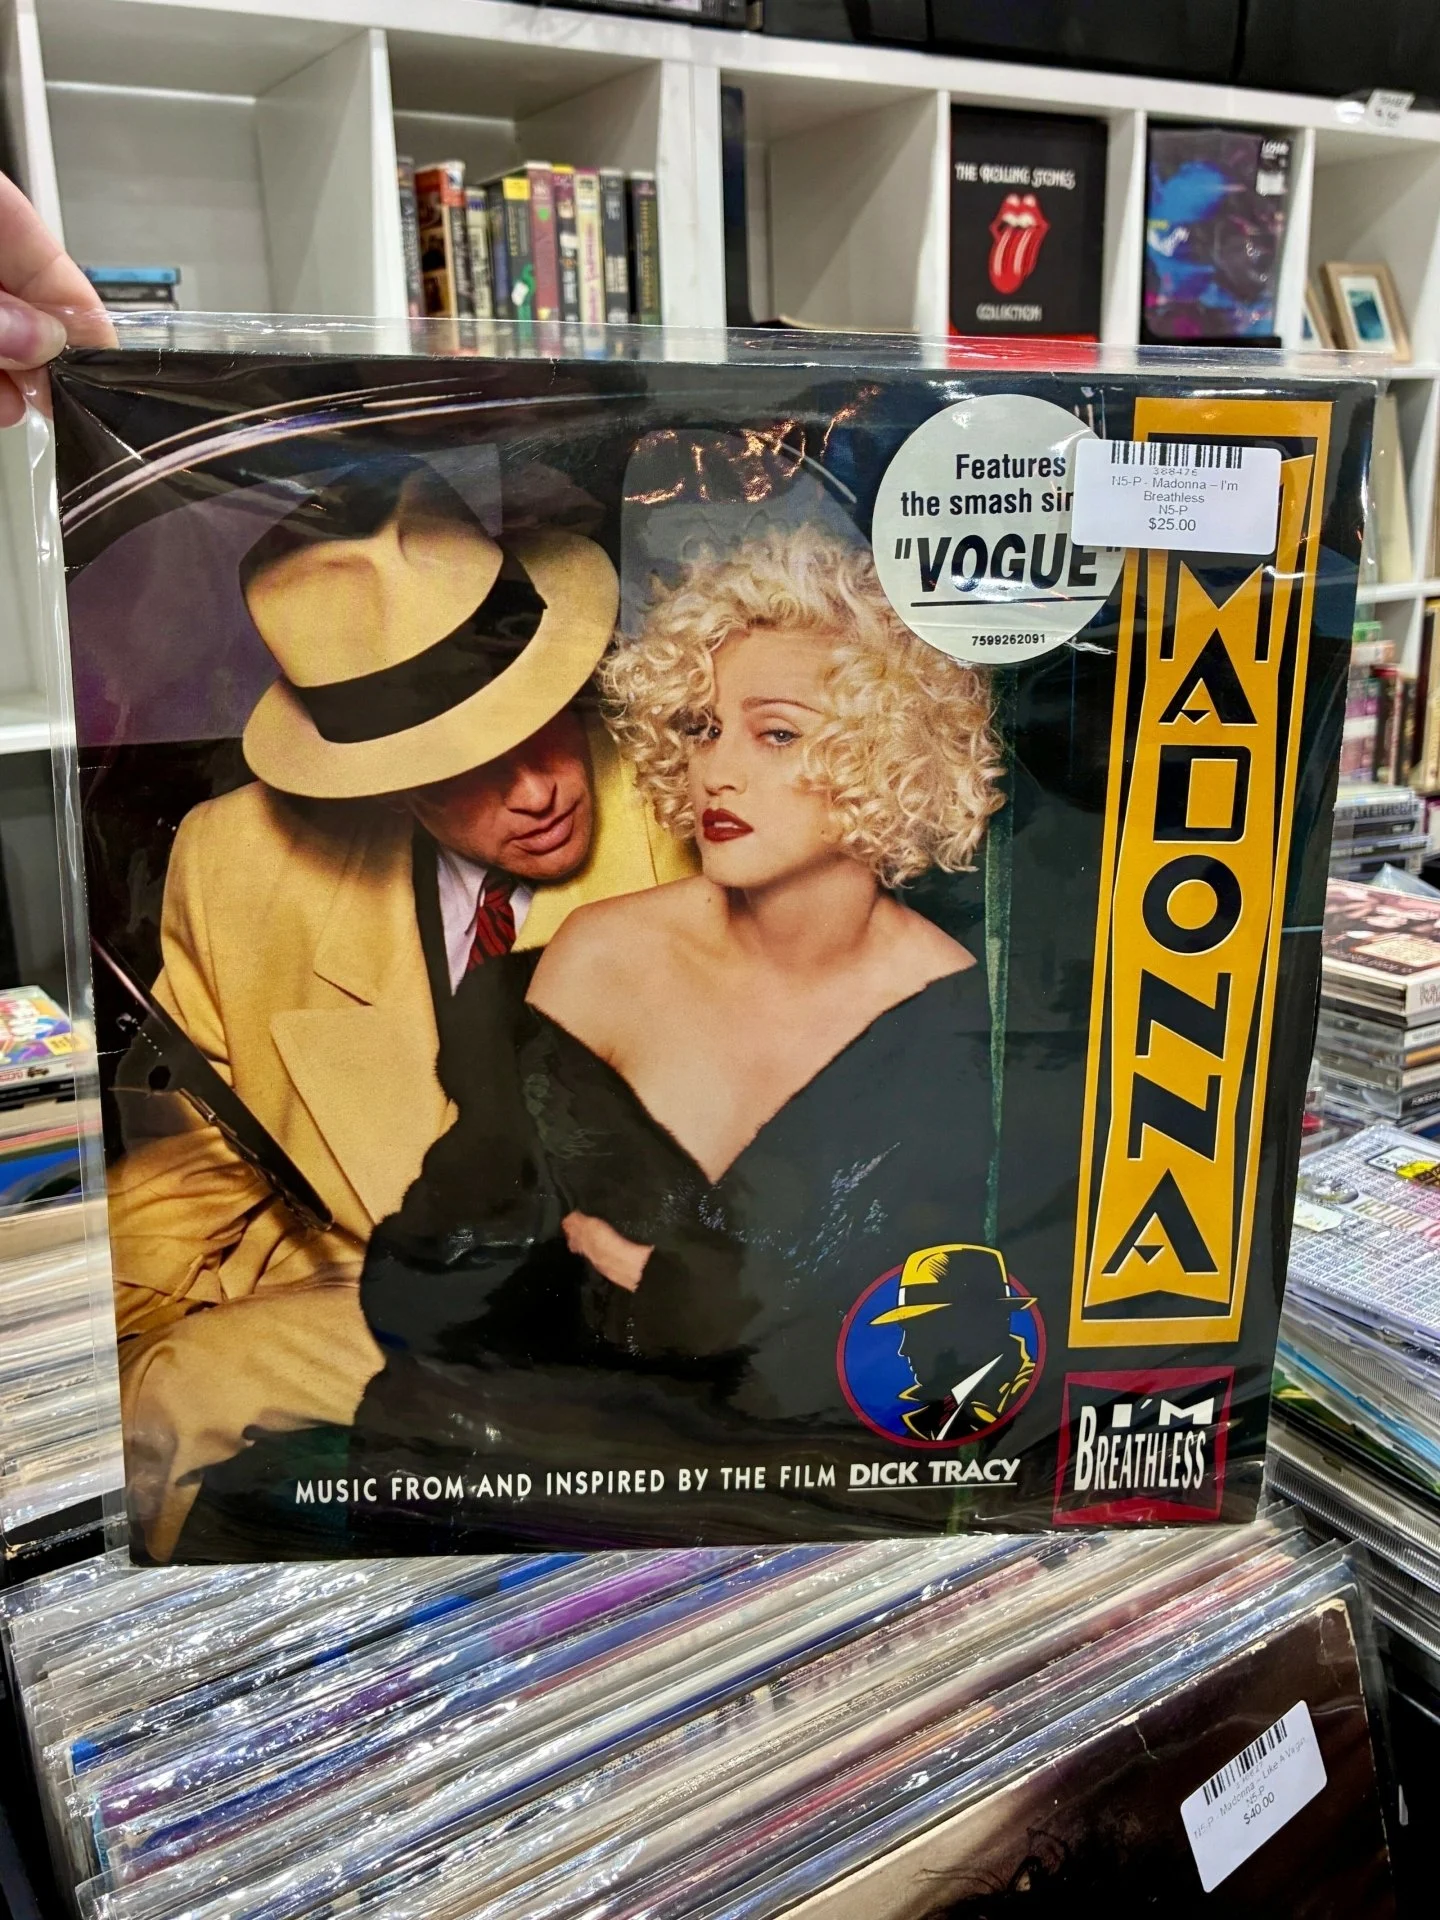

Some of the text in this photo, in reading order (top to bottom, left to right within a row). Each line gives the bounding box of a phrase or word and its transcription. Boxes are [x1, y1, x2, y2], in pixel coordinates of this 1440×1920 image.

[955, 162, 1076, 190] THE ROLLING STONES
[976, 302, 1043, 321] COLLECTION
[956, 453, 1067, 480] Features
[1111, 476, 1142, 487] N5-P
[1152, 477, 1207, 490] Madonna
[1220, 480, 1239, 491] I'm
[1144, 491, 1205, 503] Breathless
[901, 491, 940, 516] the
[949, 487, 1032, 515] smash
[1159, 504, 1188, 516] N5-P
[1149, 517, 1196, 531] $25.00
[971, 633, 1046, 646] 7599262091
[1102, 484, 1284, 1275] MADONNA
[1074, 1406, 1206, 1491] BREATHLESS
[295, 1458, 1021, 1504] MUSIC FROM AND INSPIRED BY THE FILM DICK TRACY
[1219, 1782, 1256, 1816] Madonna
[1262, 1762, 1279, 1779] Like
[1243, 1791, 1275, 1825] $40.00
